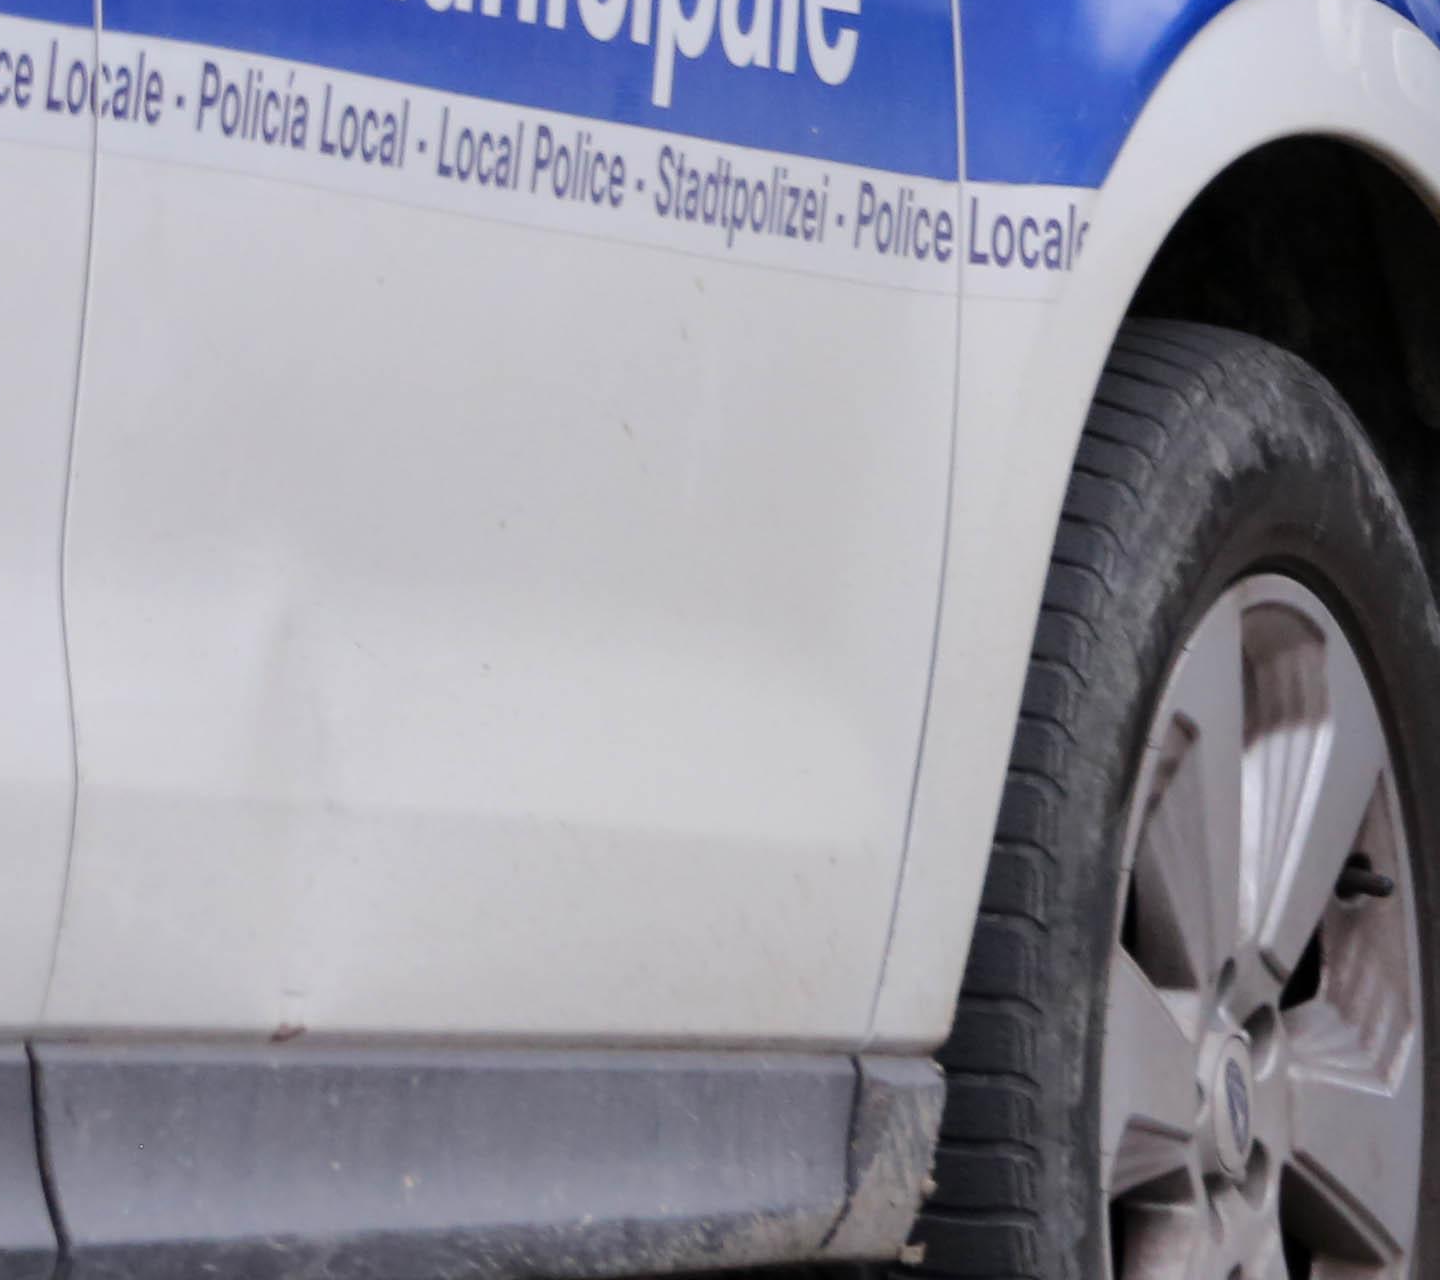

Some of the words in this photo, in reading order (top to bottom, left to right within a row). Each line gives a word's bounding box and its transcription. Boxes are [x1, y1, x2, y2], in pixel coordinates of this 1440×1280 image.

[45, 40, 163, 127] Locale
[319, 82, 410, 169] Local
[436, 104, 526, 193] Local
[529, 121, 625, 210] Police
[654, 142, 832, 249] Stadtpolizei
[853, 179, 954, 264] Police
